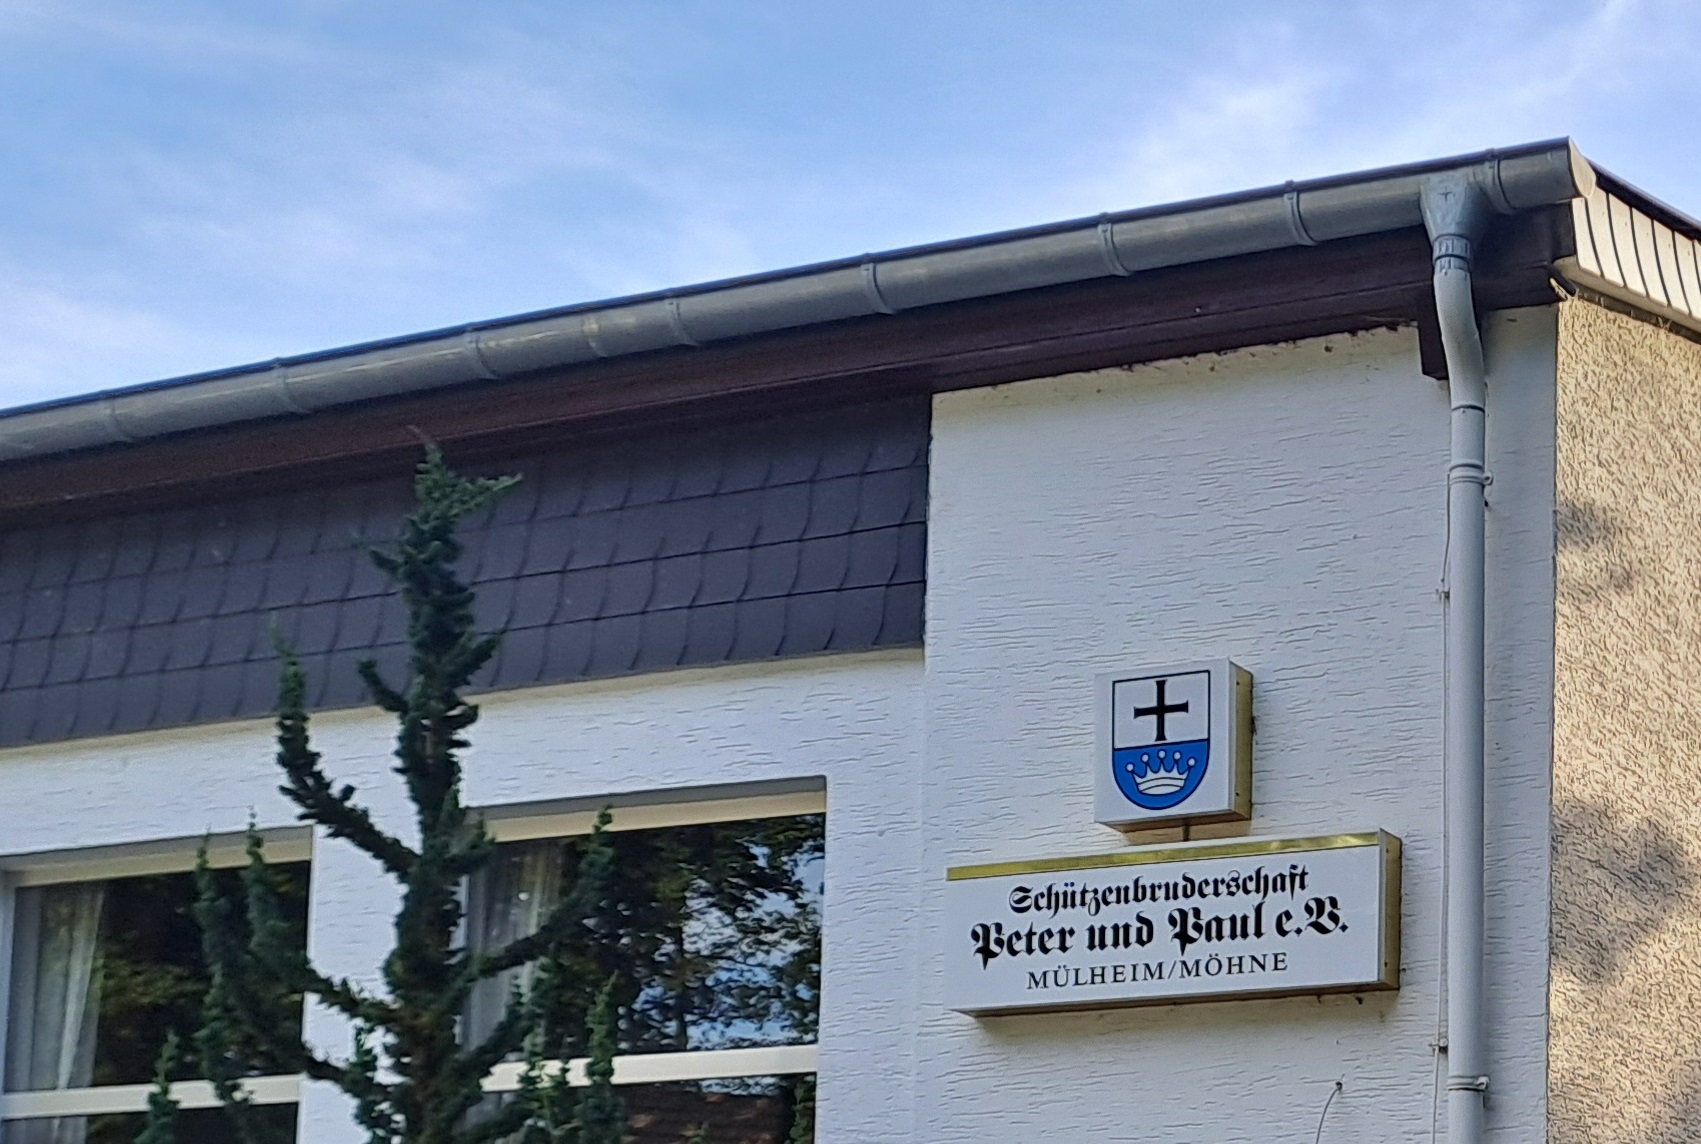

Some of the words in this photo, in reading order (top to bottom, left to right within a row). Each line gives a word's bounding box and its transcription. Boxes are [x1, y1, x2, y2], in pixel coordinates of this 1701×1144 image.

[1008, 863, 1309, 919] Schützenbruderschaft
[970, 921, 1076, 971] Peter
[1085, 910, 1154, 952] und
[1167, 900, 1266, 957] Paul
[1275, 895, 1349, 938] e.V.
[1026, 952, 1288, 990] MÜLHEIM/MÖHNE
